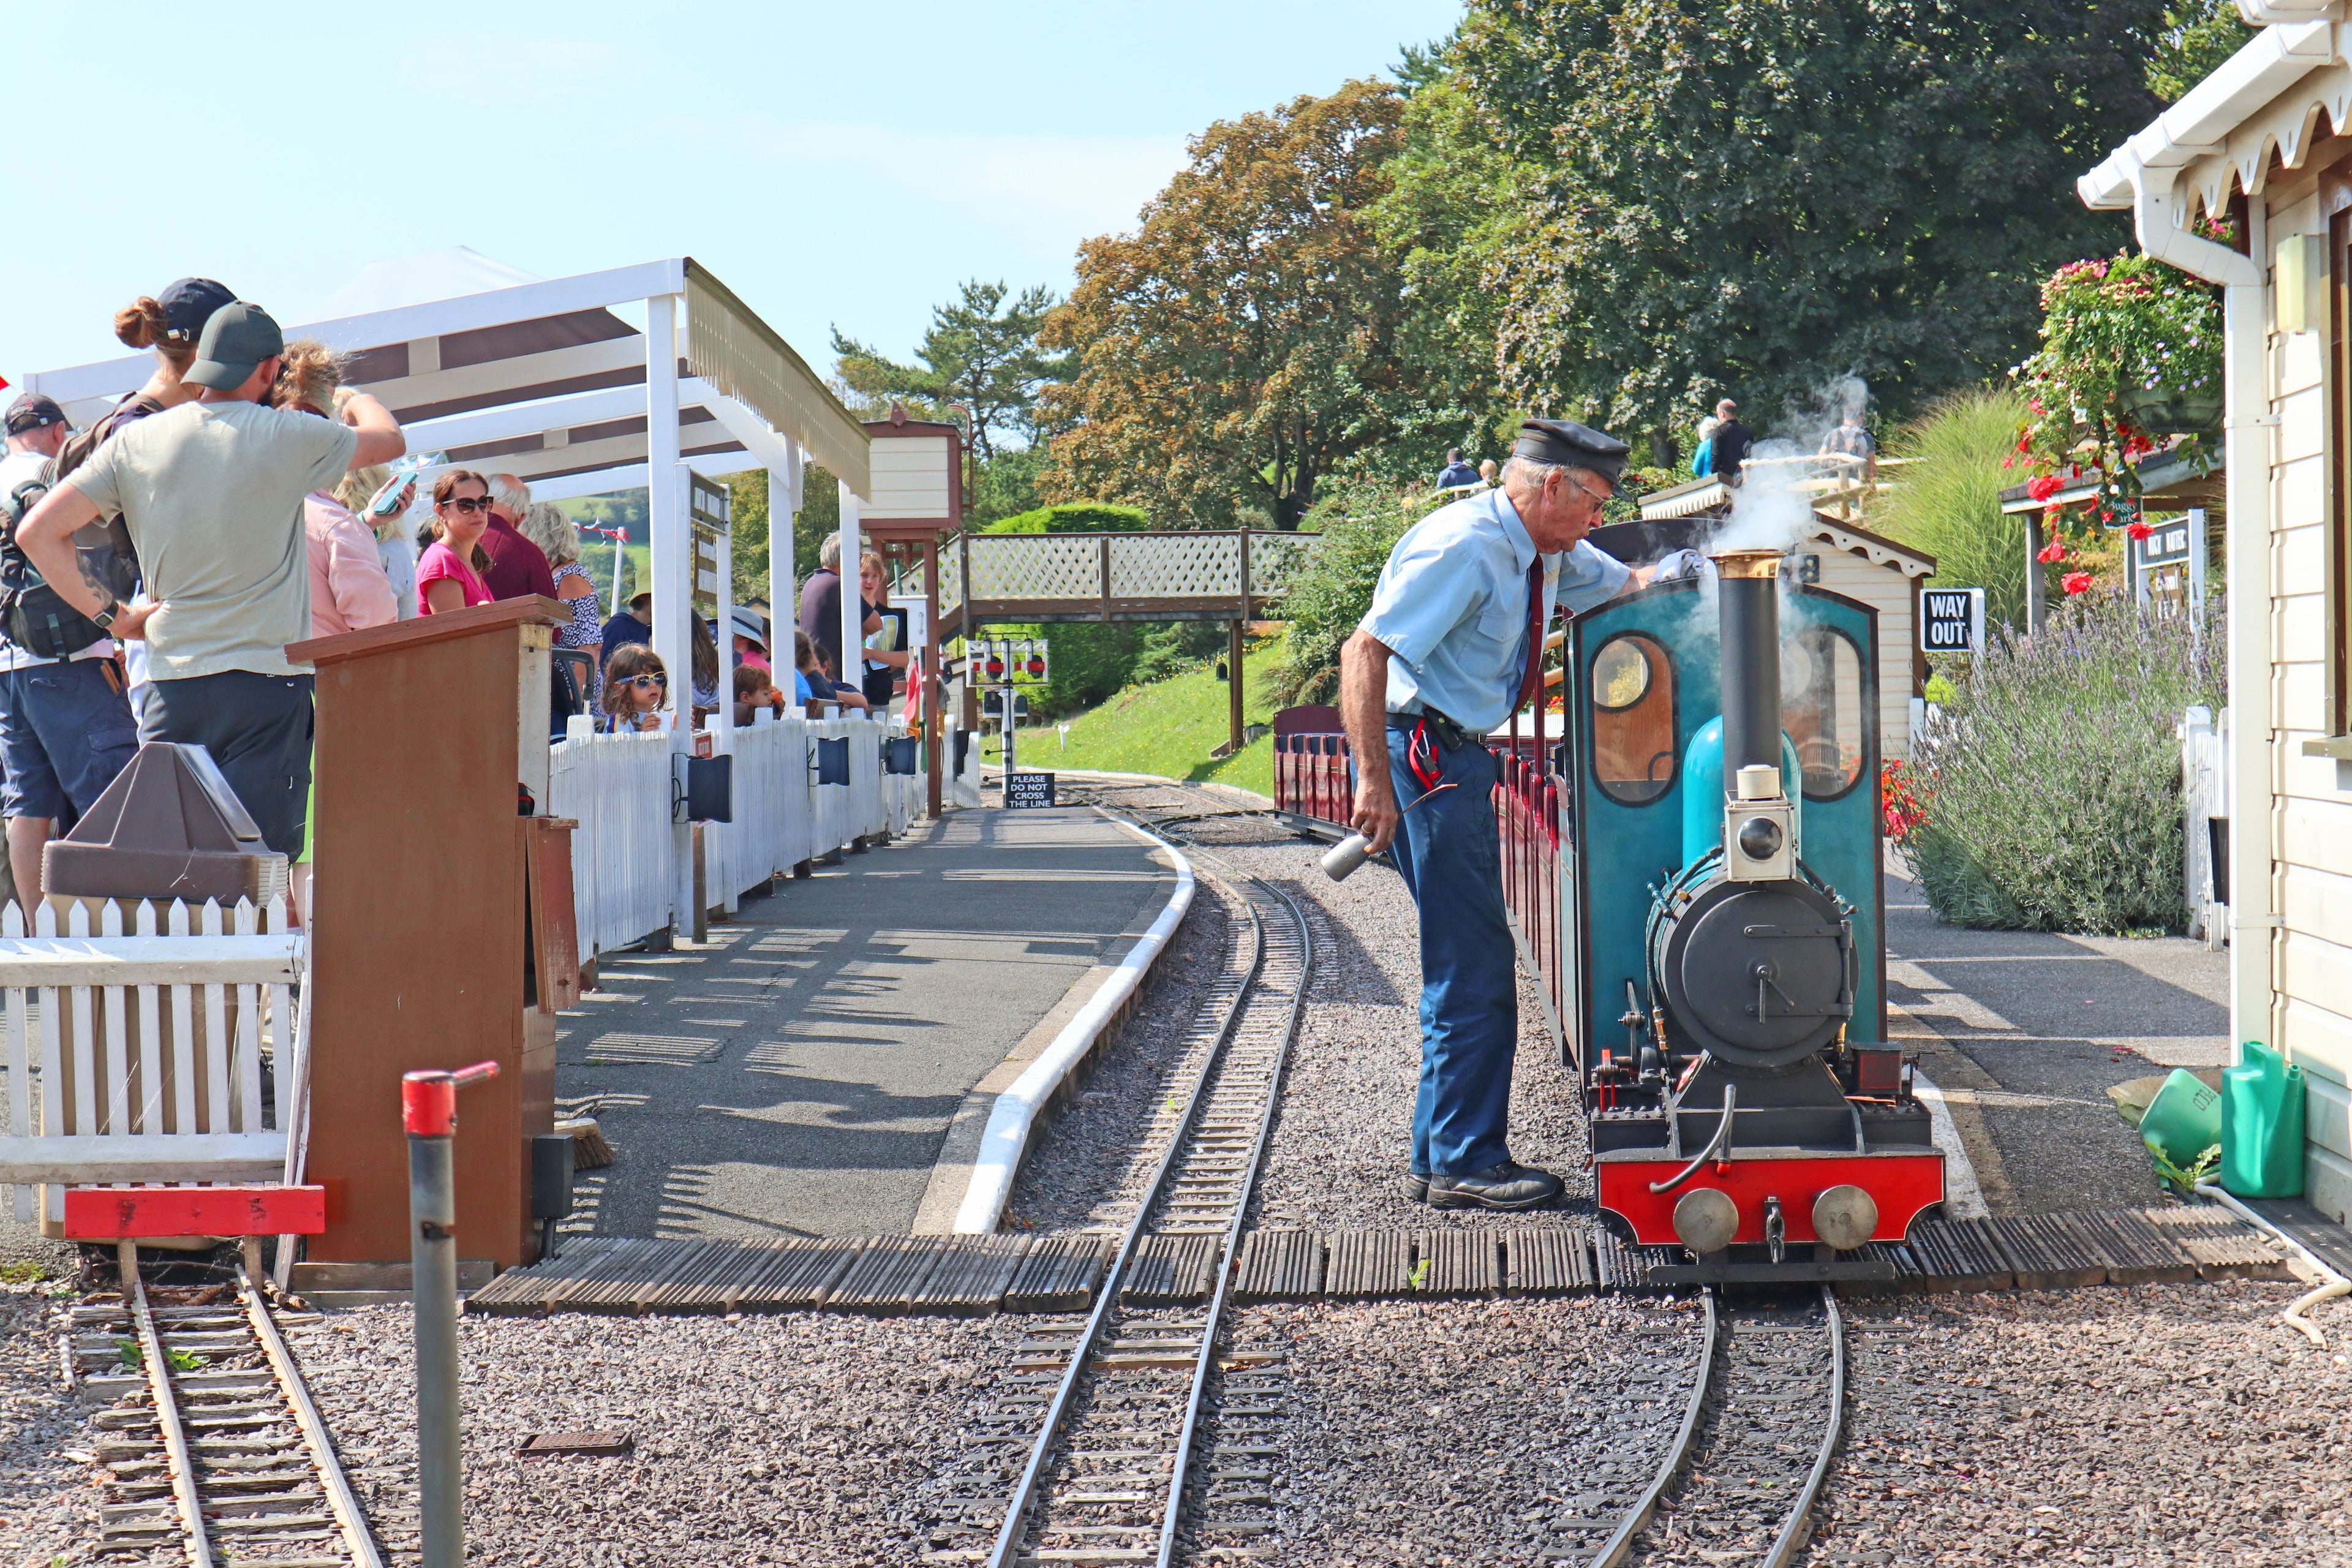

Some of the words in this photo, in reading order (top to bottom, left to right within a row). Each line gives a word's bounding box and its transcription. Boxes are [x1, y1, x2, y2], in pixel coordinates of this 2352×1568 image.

[2120, 513, 2134, 523] ark
[1930, 595, 1967, 618] WAY
[1931, 622, 1966, 645] OUT
[2193, 1085, 2217, 1112] PECO
